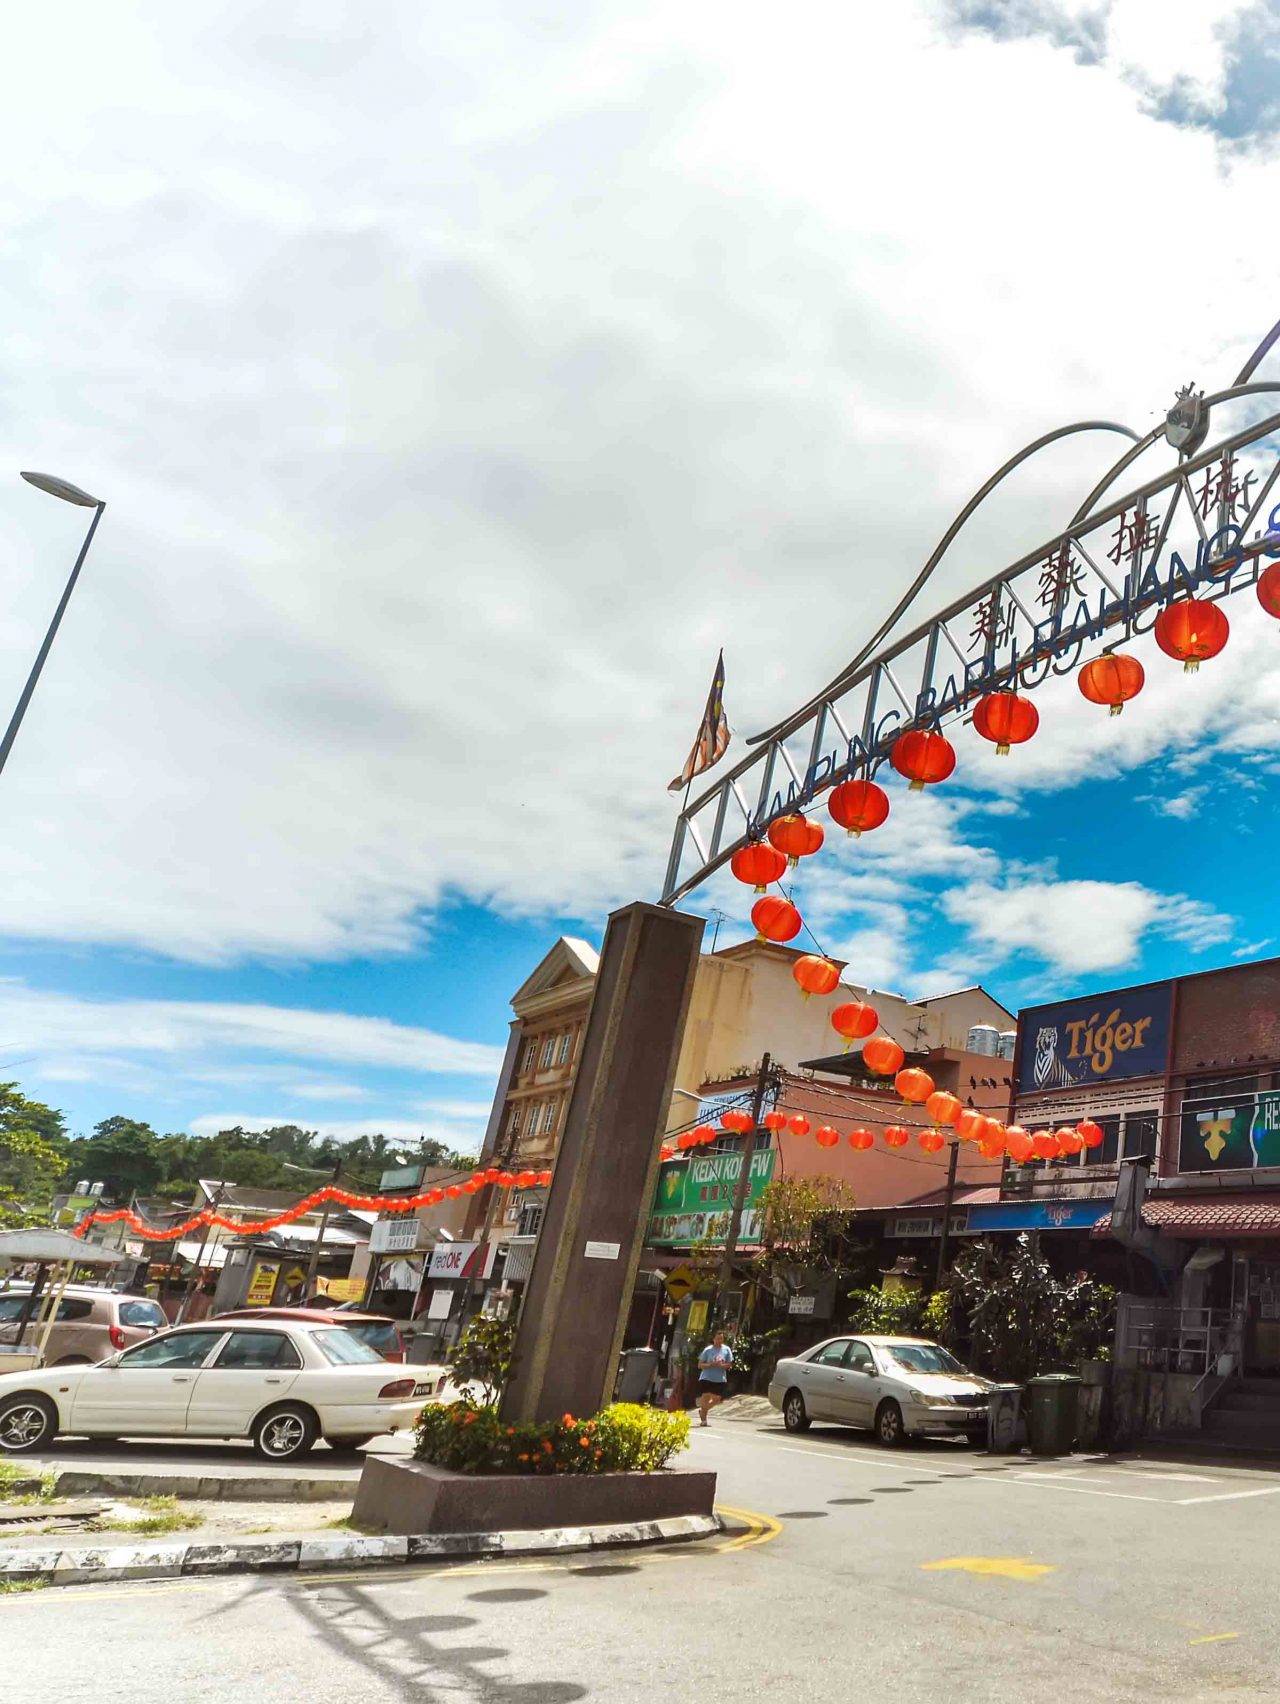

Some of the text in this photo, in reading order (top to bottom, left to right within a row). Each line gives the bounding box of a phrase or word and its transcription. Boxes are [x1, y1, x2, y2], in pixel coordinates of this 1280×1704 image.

[913, 636, 1018, 730] BARU
[1031, 523, 1245, 673] RAHANG
[1065, 1008, 1152, 1074] Tiger
[691, 1159, 723, 1183] KEDAI
